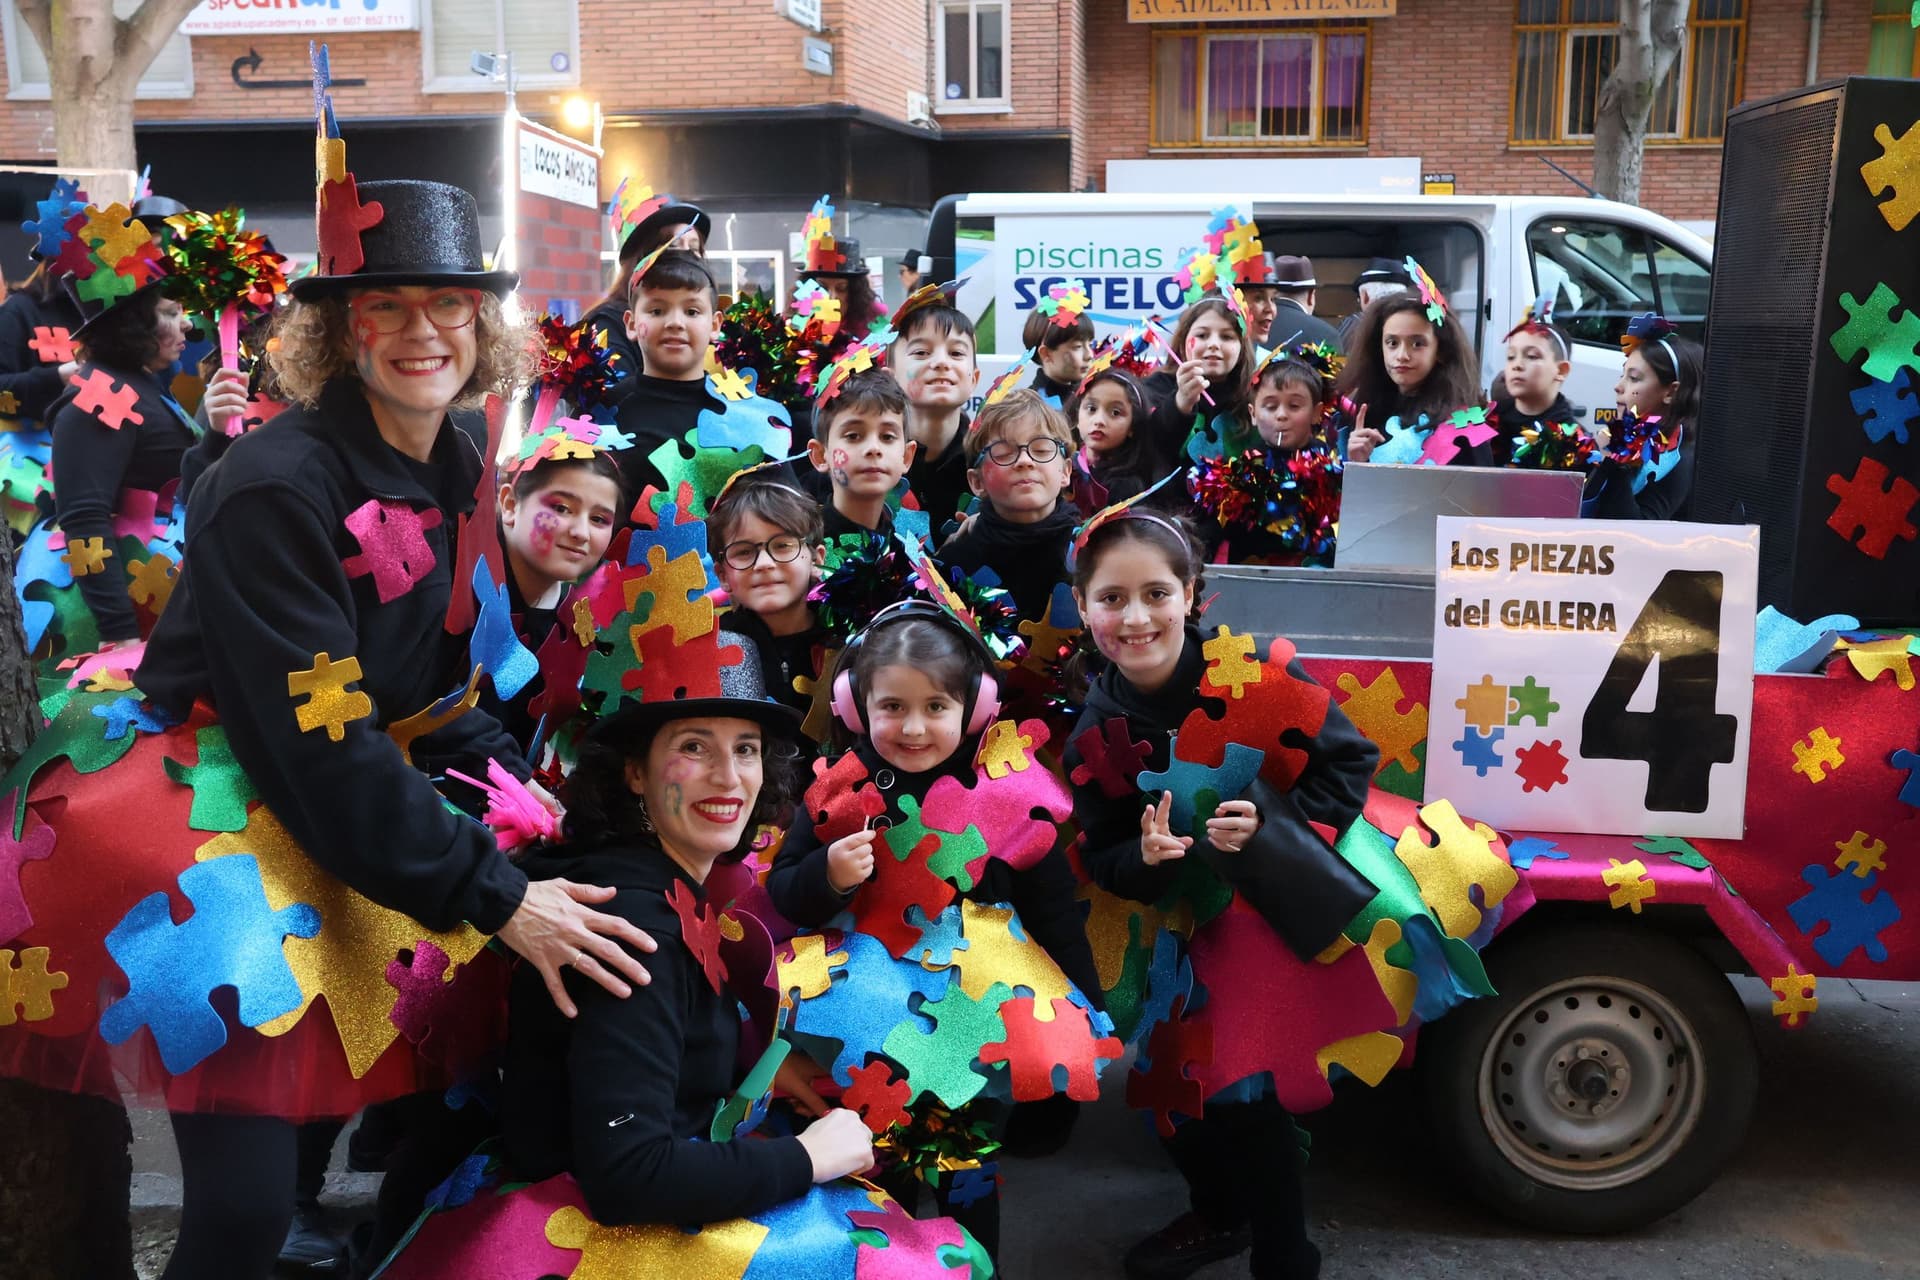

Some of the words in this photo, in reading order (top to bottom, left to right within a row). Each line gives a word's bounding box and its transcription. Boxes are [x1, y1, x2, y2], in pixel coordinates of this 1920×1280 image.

[534, 143, 561, 180] LOCOS
[1015, 242, 1163, 275] piscinas
[1450, 540, 1499, 572] Los
[1509, 542, 1615, 576] PIEZAS
[1444, 597, 1490, 628] del
[1499, 599, 1617, 633] GALERA
[1579, 569, 1738, 813] 4
